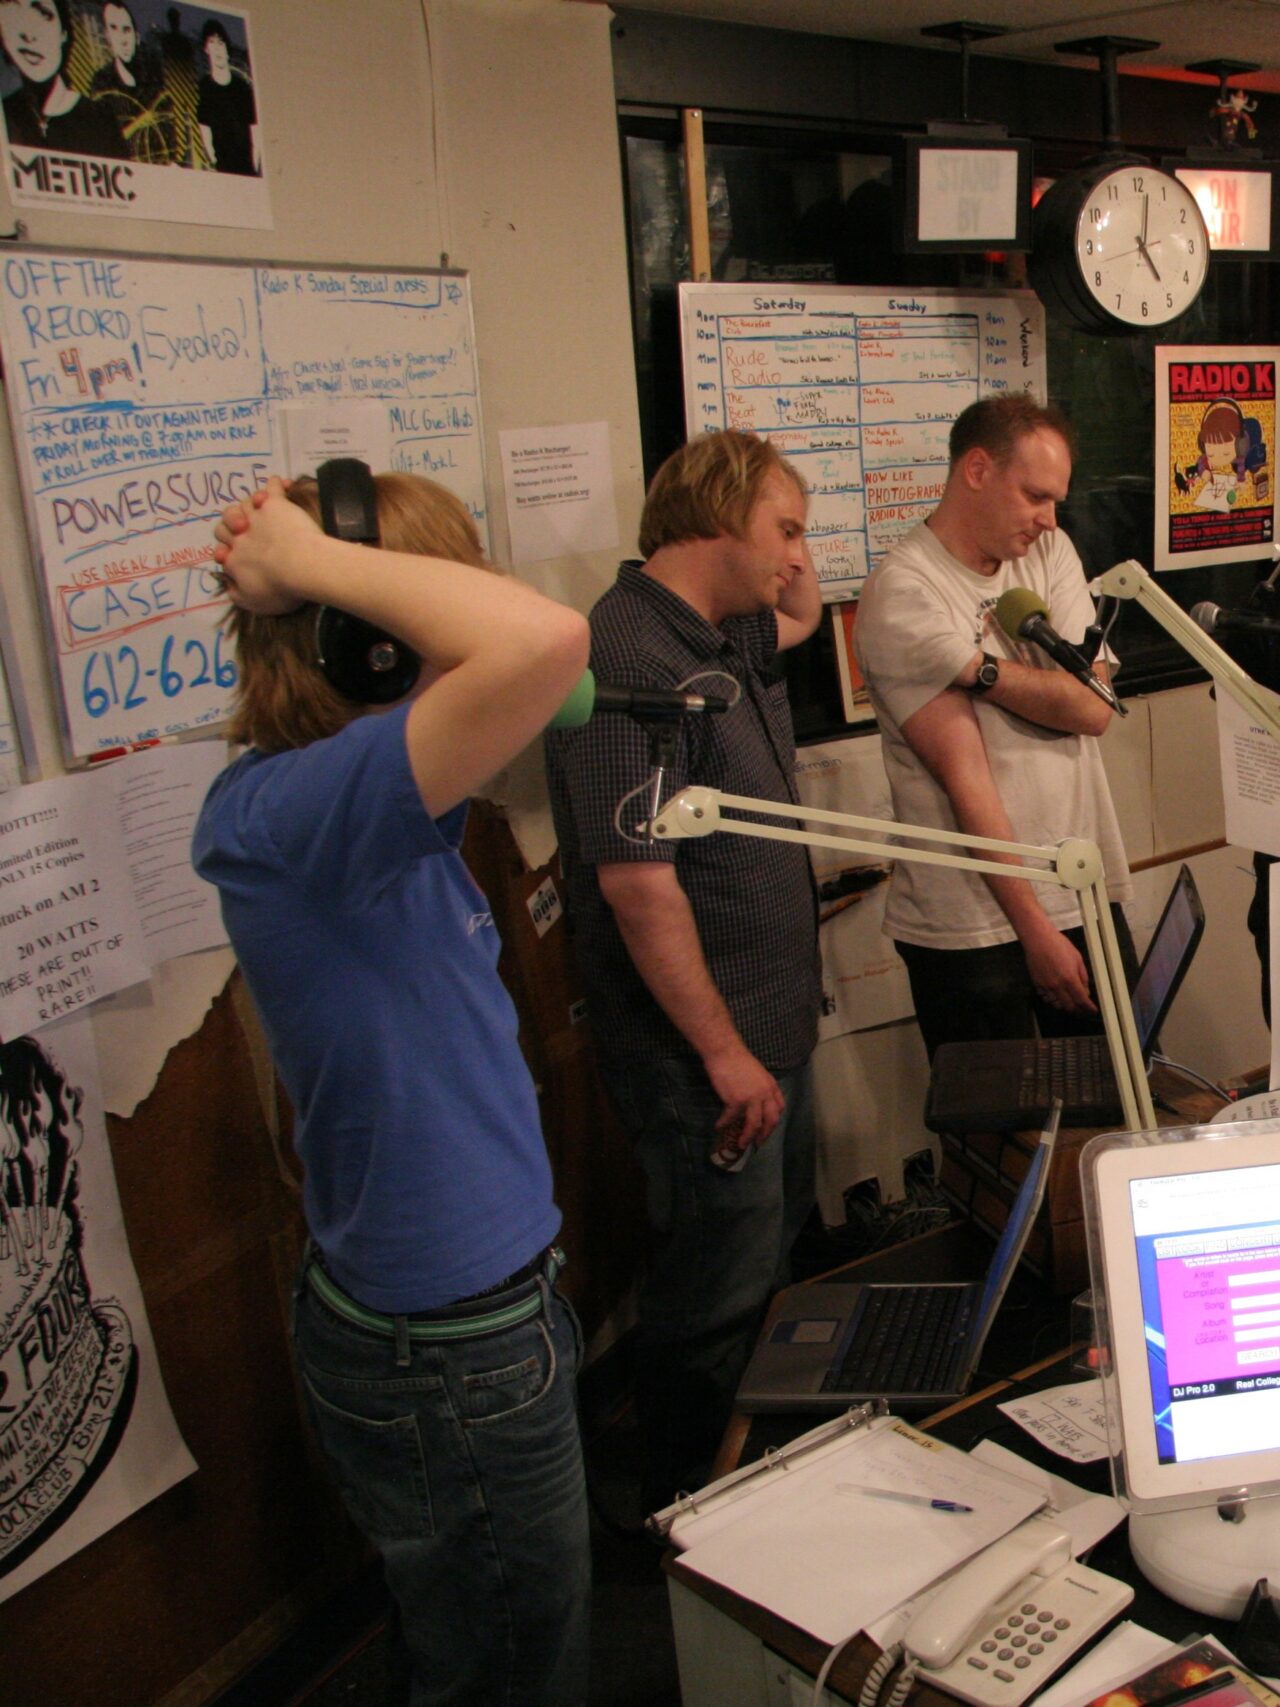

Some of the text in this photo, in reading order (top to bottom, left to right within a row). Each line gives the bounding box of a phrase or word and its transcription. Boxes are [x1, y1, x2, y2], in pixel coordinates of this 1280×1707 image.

[9, 150, 136, 201] METRIC
[1132, 177, 1144, 192] 12
[1107, 186, 1118, 200] 11
[1161, 187, 1166, 200] 1
[1208, 177, 1239, 211] ON
[1089, 208, 1100, 222] 10
[1179, 208, 1187, 224] 2
[1086, 239, 1093, 255] 9
[1188, 240, 1195, 254] 3
[5, 259, 127, 299] OFF THE
[1095, 271, 1102, 286] 8
[1182, 270, 1190, 284] 4
[1115, 294, 1122, 309] 7
[1141, 302, 1148, 317] 6
[1166, 293, 1173, 308] 5
[22, 304, 132, 349] RECORD
[725, 345, 769, 367] Rude
[20, 358, 61, 405] Fri
[731, 367, 783, 386] Radio
[1171, 363, 1274, 394] RADIO K
[865, 471, 914, 484] NOW LIKE
[53, 463, 269, 545] POWERSURGE
[867, 483, 946, 505] PHOTOGRAPHS
[869, 508, 896, 525] RADIO
[35, 837, 79, 857] Edition
[0, 850, 85, 888] NLY 15 Copies
[36, 898, 54, 912] on
[60, 883, 86, 904] AM
[91, 879, 100, 893] 2
[18, 916, 99, 960] 20 WATTS
[37, 952, 65, 977] ARE
[72, 938, 103, 962] OUT
[106, 933, 125, 951] OF
[36, 965, 93, 1002] PRINT!!
[39, 984, 97, 1022] RARE!!
[1204, 1300, 1226, 1313] Song
[1202, 1317, 1227, 1329] Album
[1173, 1386, 1185, 1398] DJ
[1186, 1384, 1202, 1396] Pro
[1202, 1383, 1216, 1394] 2.0
[1236, 1378, 1255, 1391] Real
[0, 1492, 41, 1541] OCK
